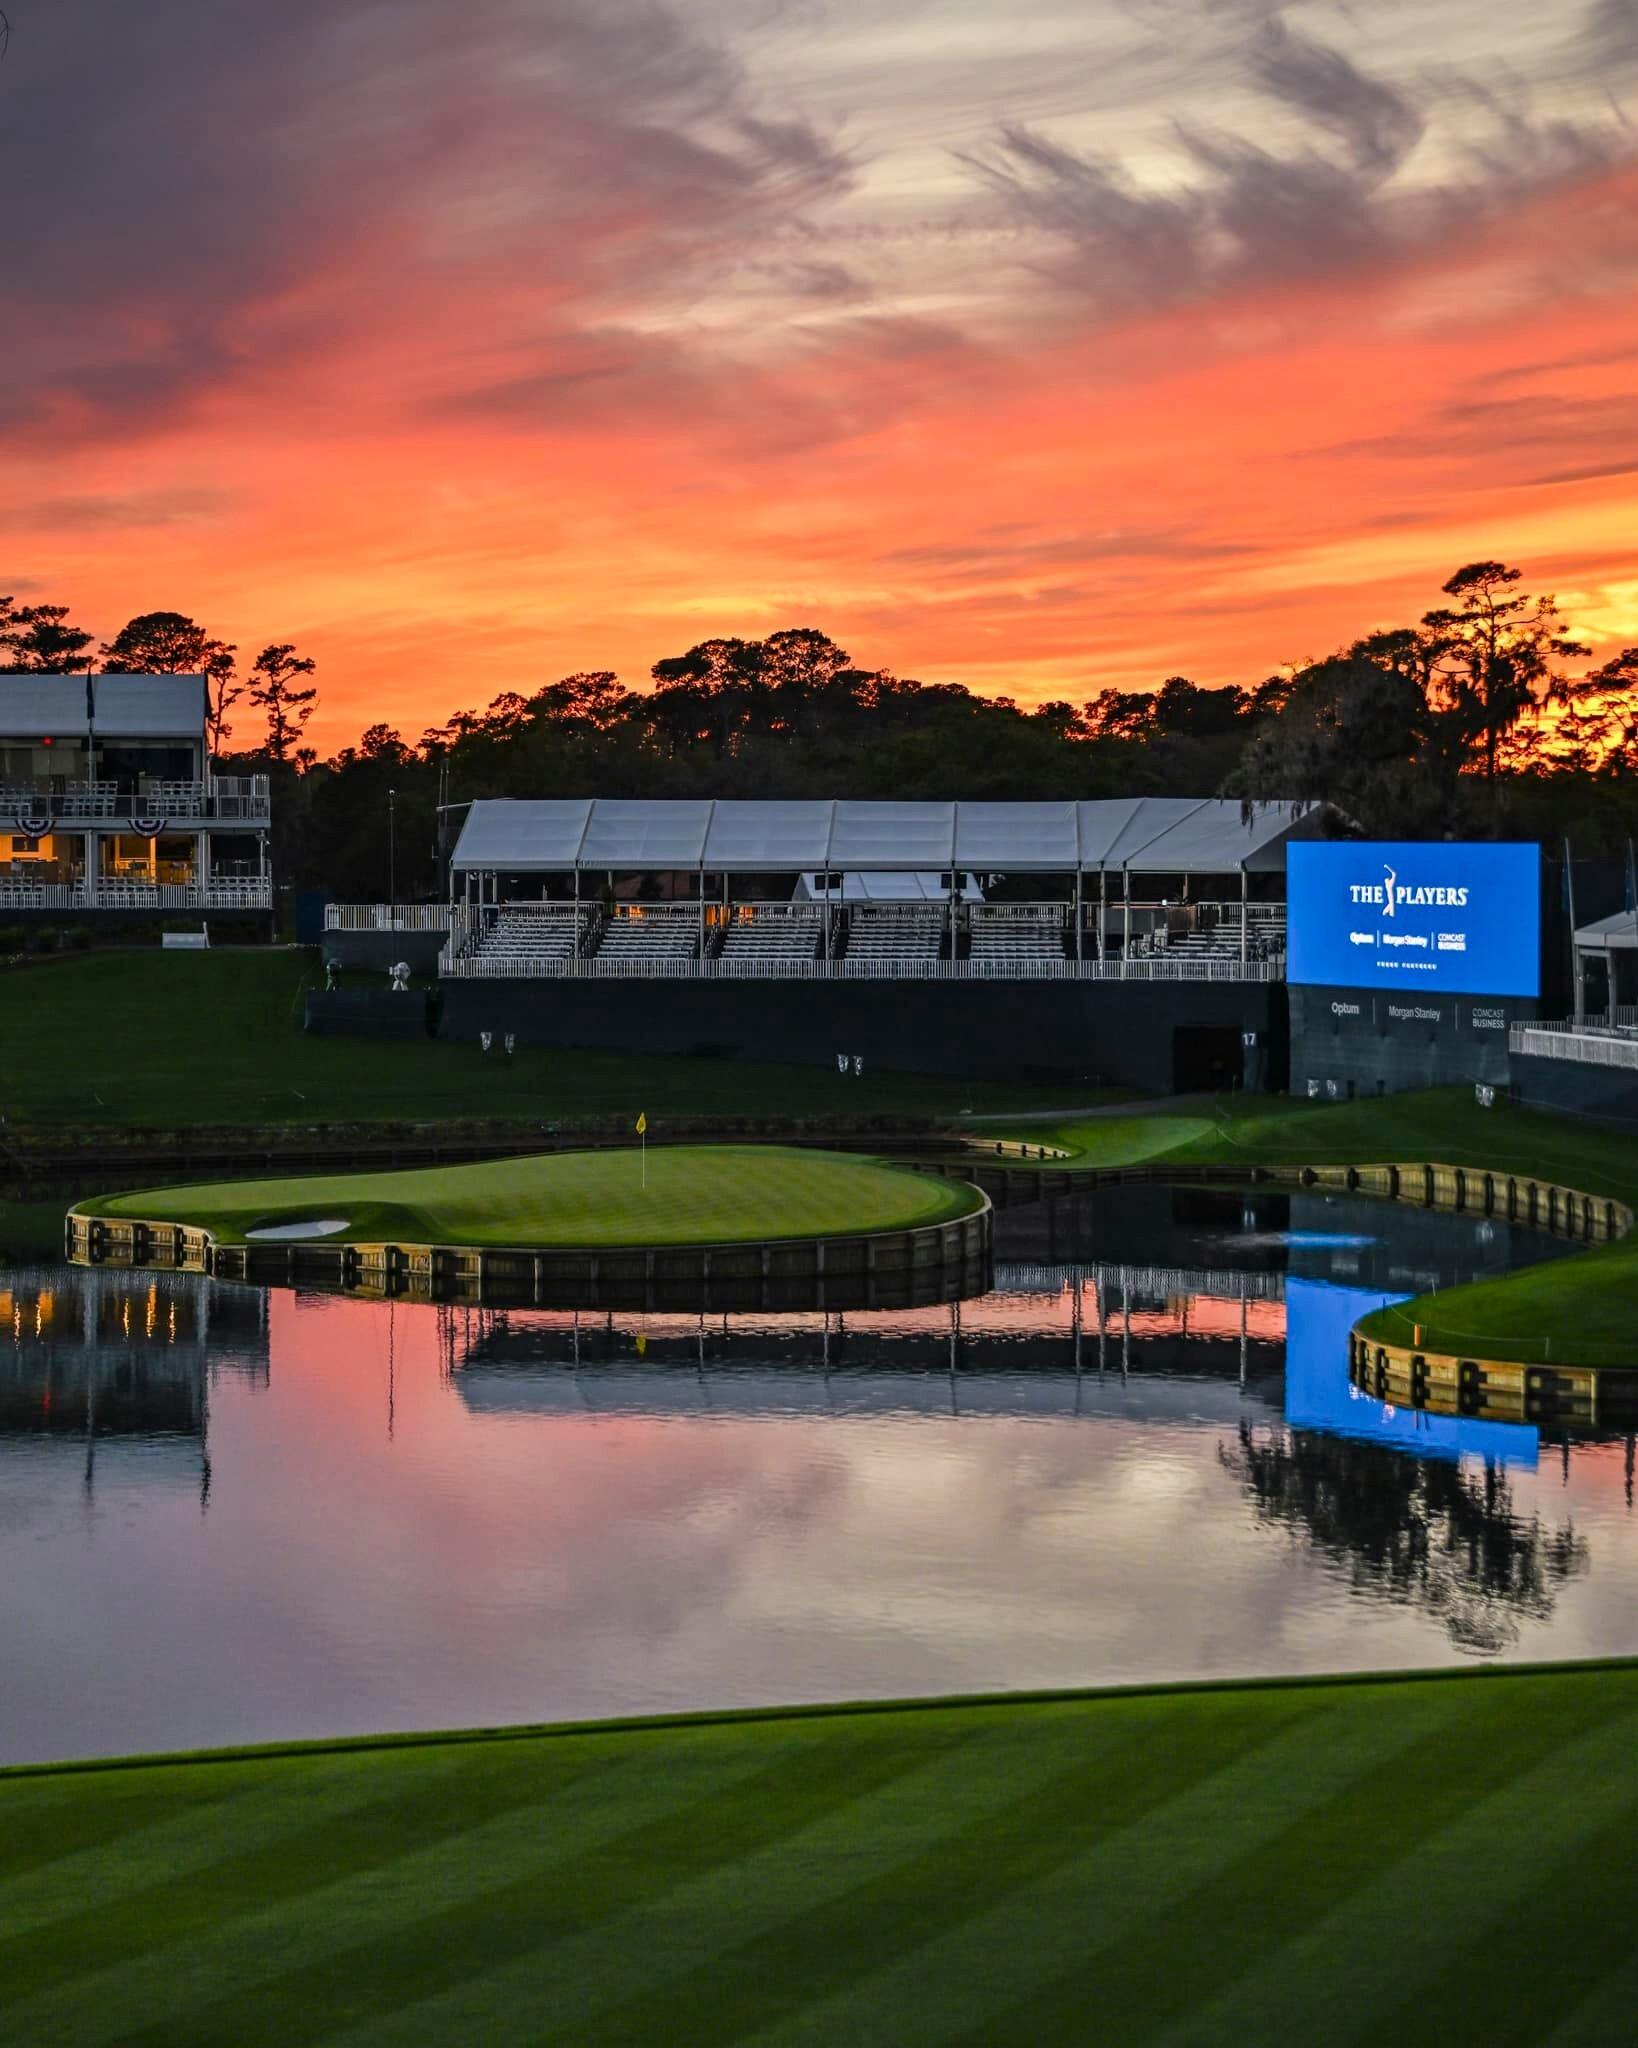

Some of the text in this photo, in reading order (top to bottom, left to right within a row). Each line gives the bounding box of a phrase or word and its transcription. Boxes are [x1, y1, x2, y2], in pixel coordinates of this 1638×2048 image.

[1350, 885, 1468, 906] THE PLAYERS
[1331, 1002, 1360, 1016] Optum
[1388, 1005, 1441, 1022] Morgan Stanley
[1472, 1008, 1505, 1018] COMCAST
[1472, 1018, 1505, 1029] BUSINESS
[1242, 1033, 1256, 1046] 17
